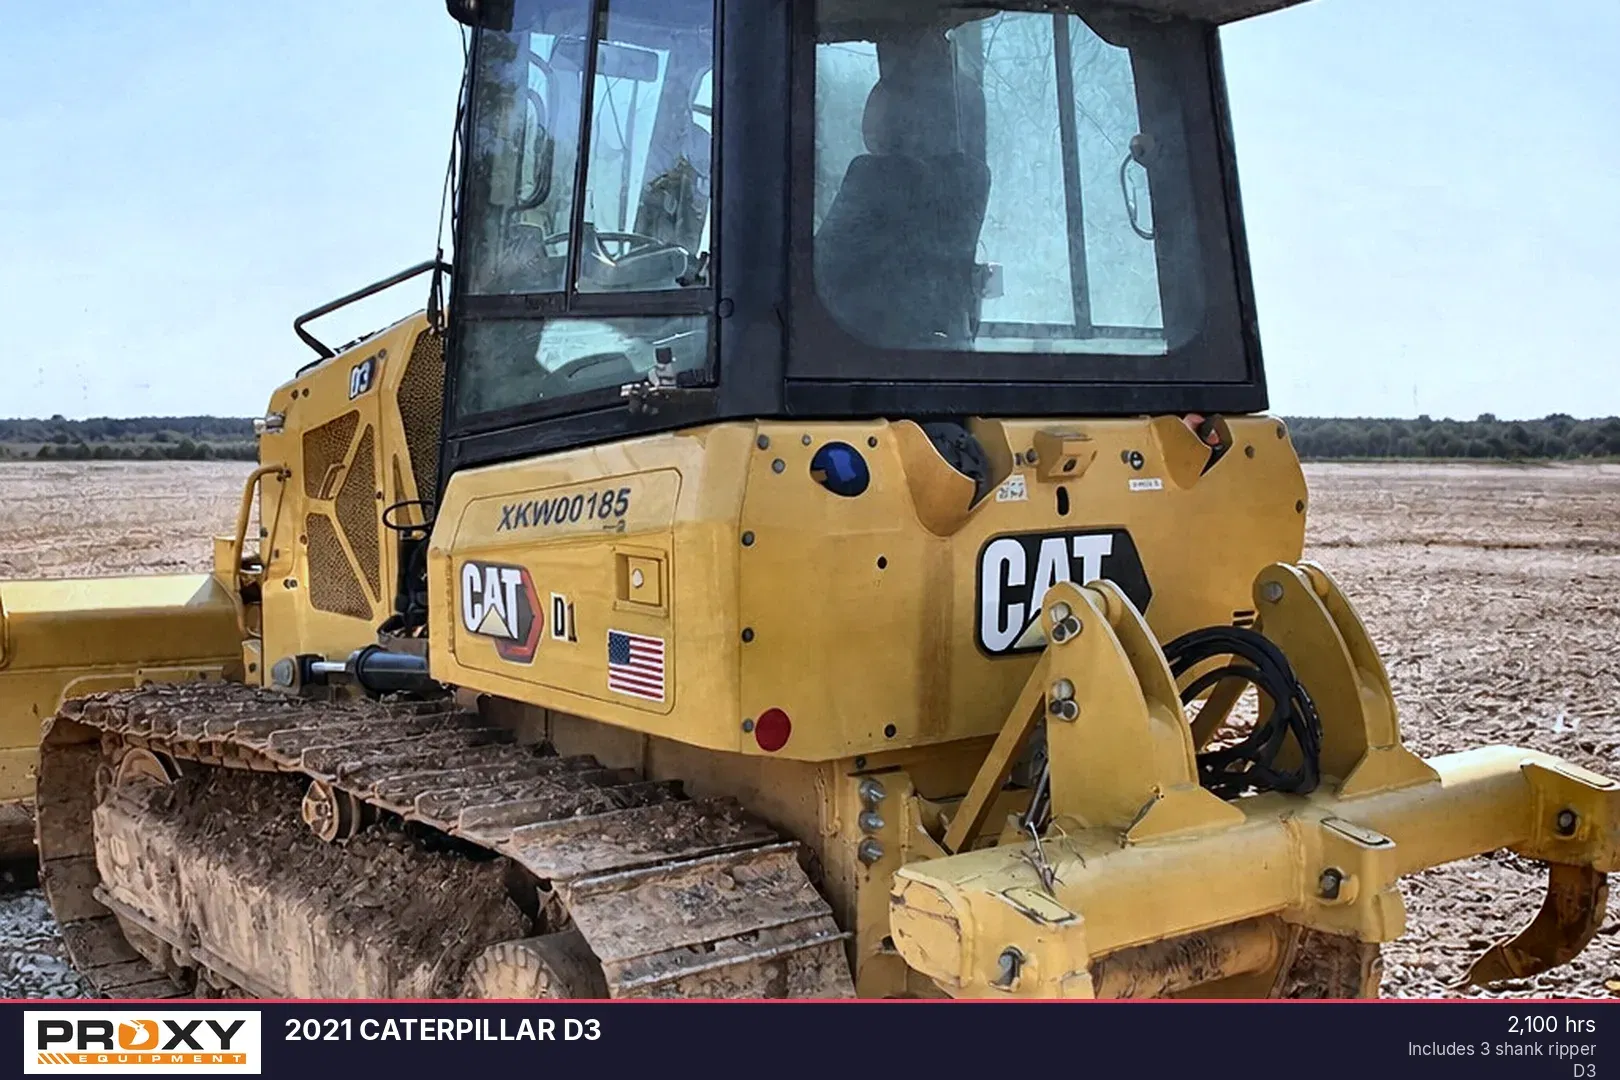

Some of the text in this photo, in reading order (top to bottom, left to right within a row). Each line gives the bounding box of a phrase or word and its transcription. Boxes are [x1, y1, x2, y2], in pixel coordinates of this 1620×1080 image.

[350, 361, 371, 399] D3
[496, 487, 631, 533] XKW00185
[462, 561, 522, 640] CAT
[981, 533, 1114, 652] CAT
